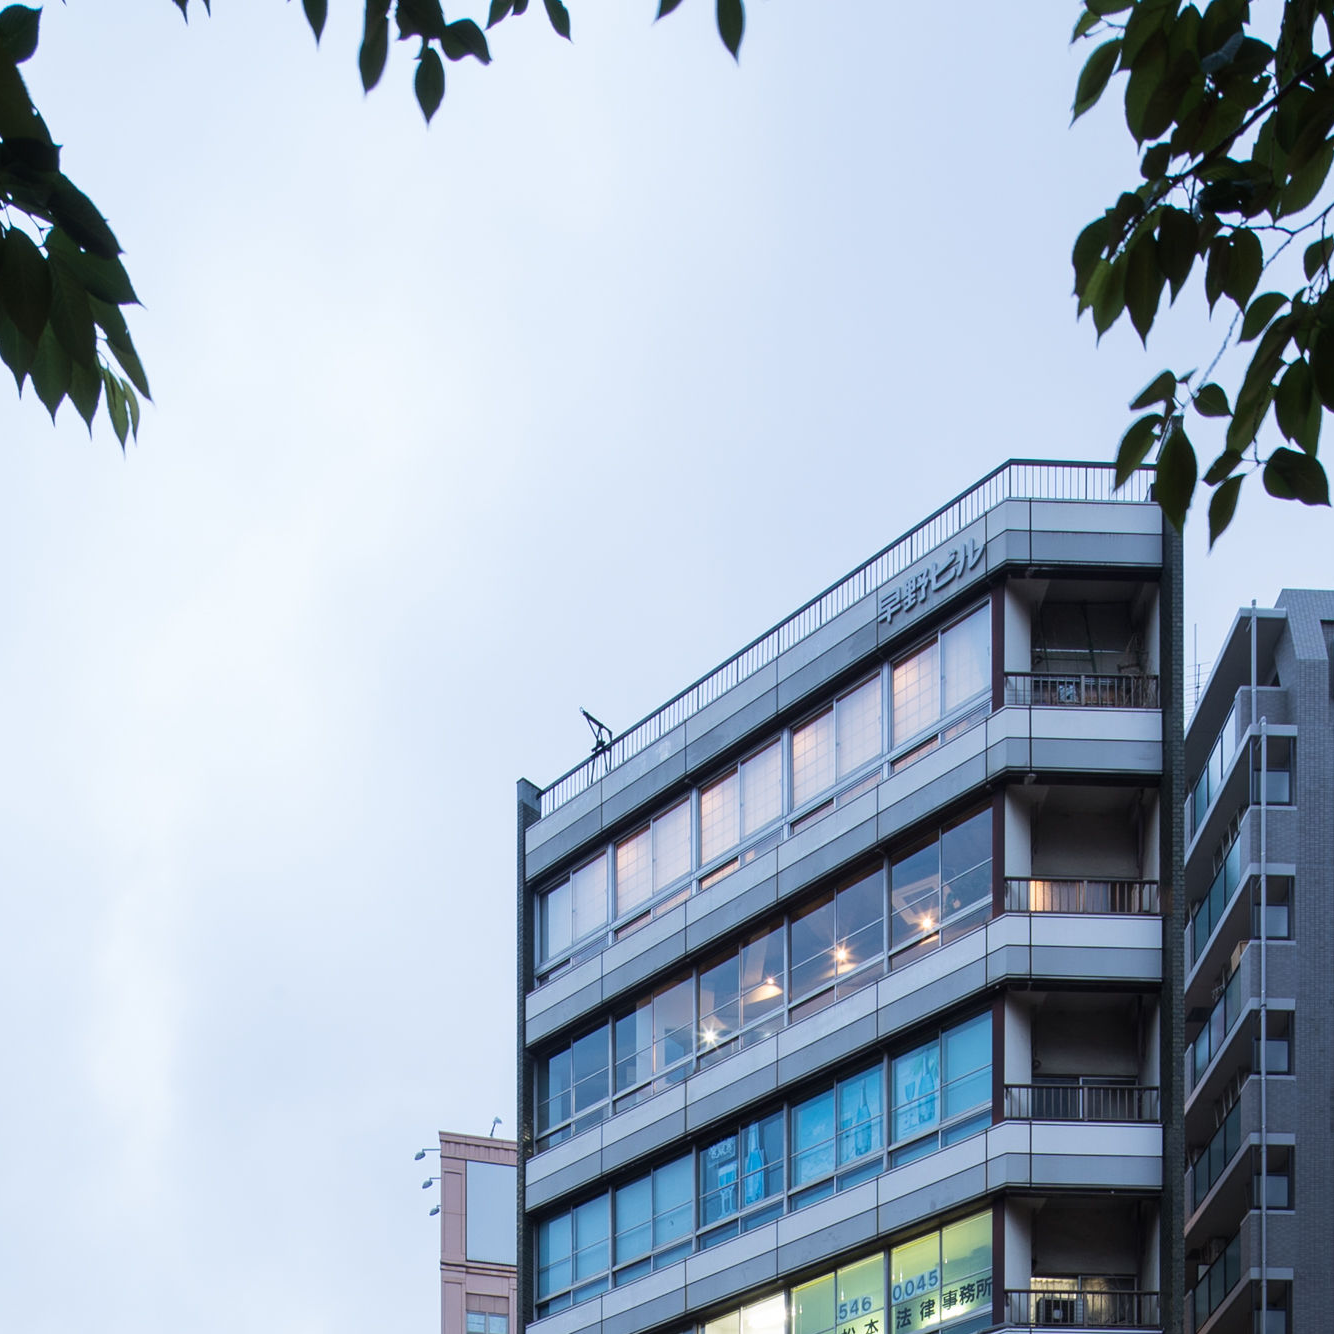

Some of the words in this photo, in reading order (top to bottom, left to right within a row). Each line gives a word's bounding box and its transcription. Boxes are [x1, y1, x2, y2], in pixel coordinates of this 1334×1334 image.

[877, 538, 985, 625] 早野ビル
[893, 1269, 939, 1302] 0045
